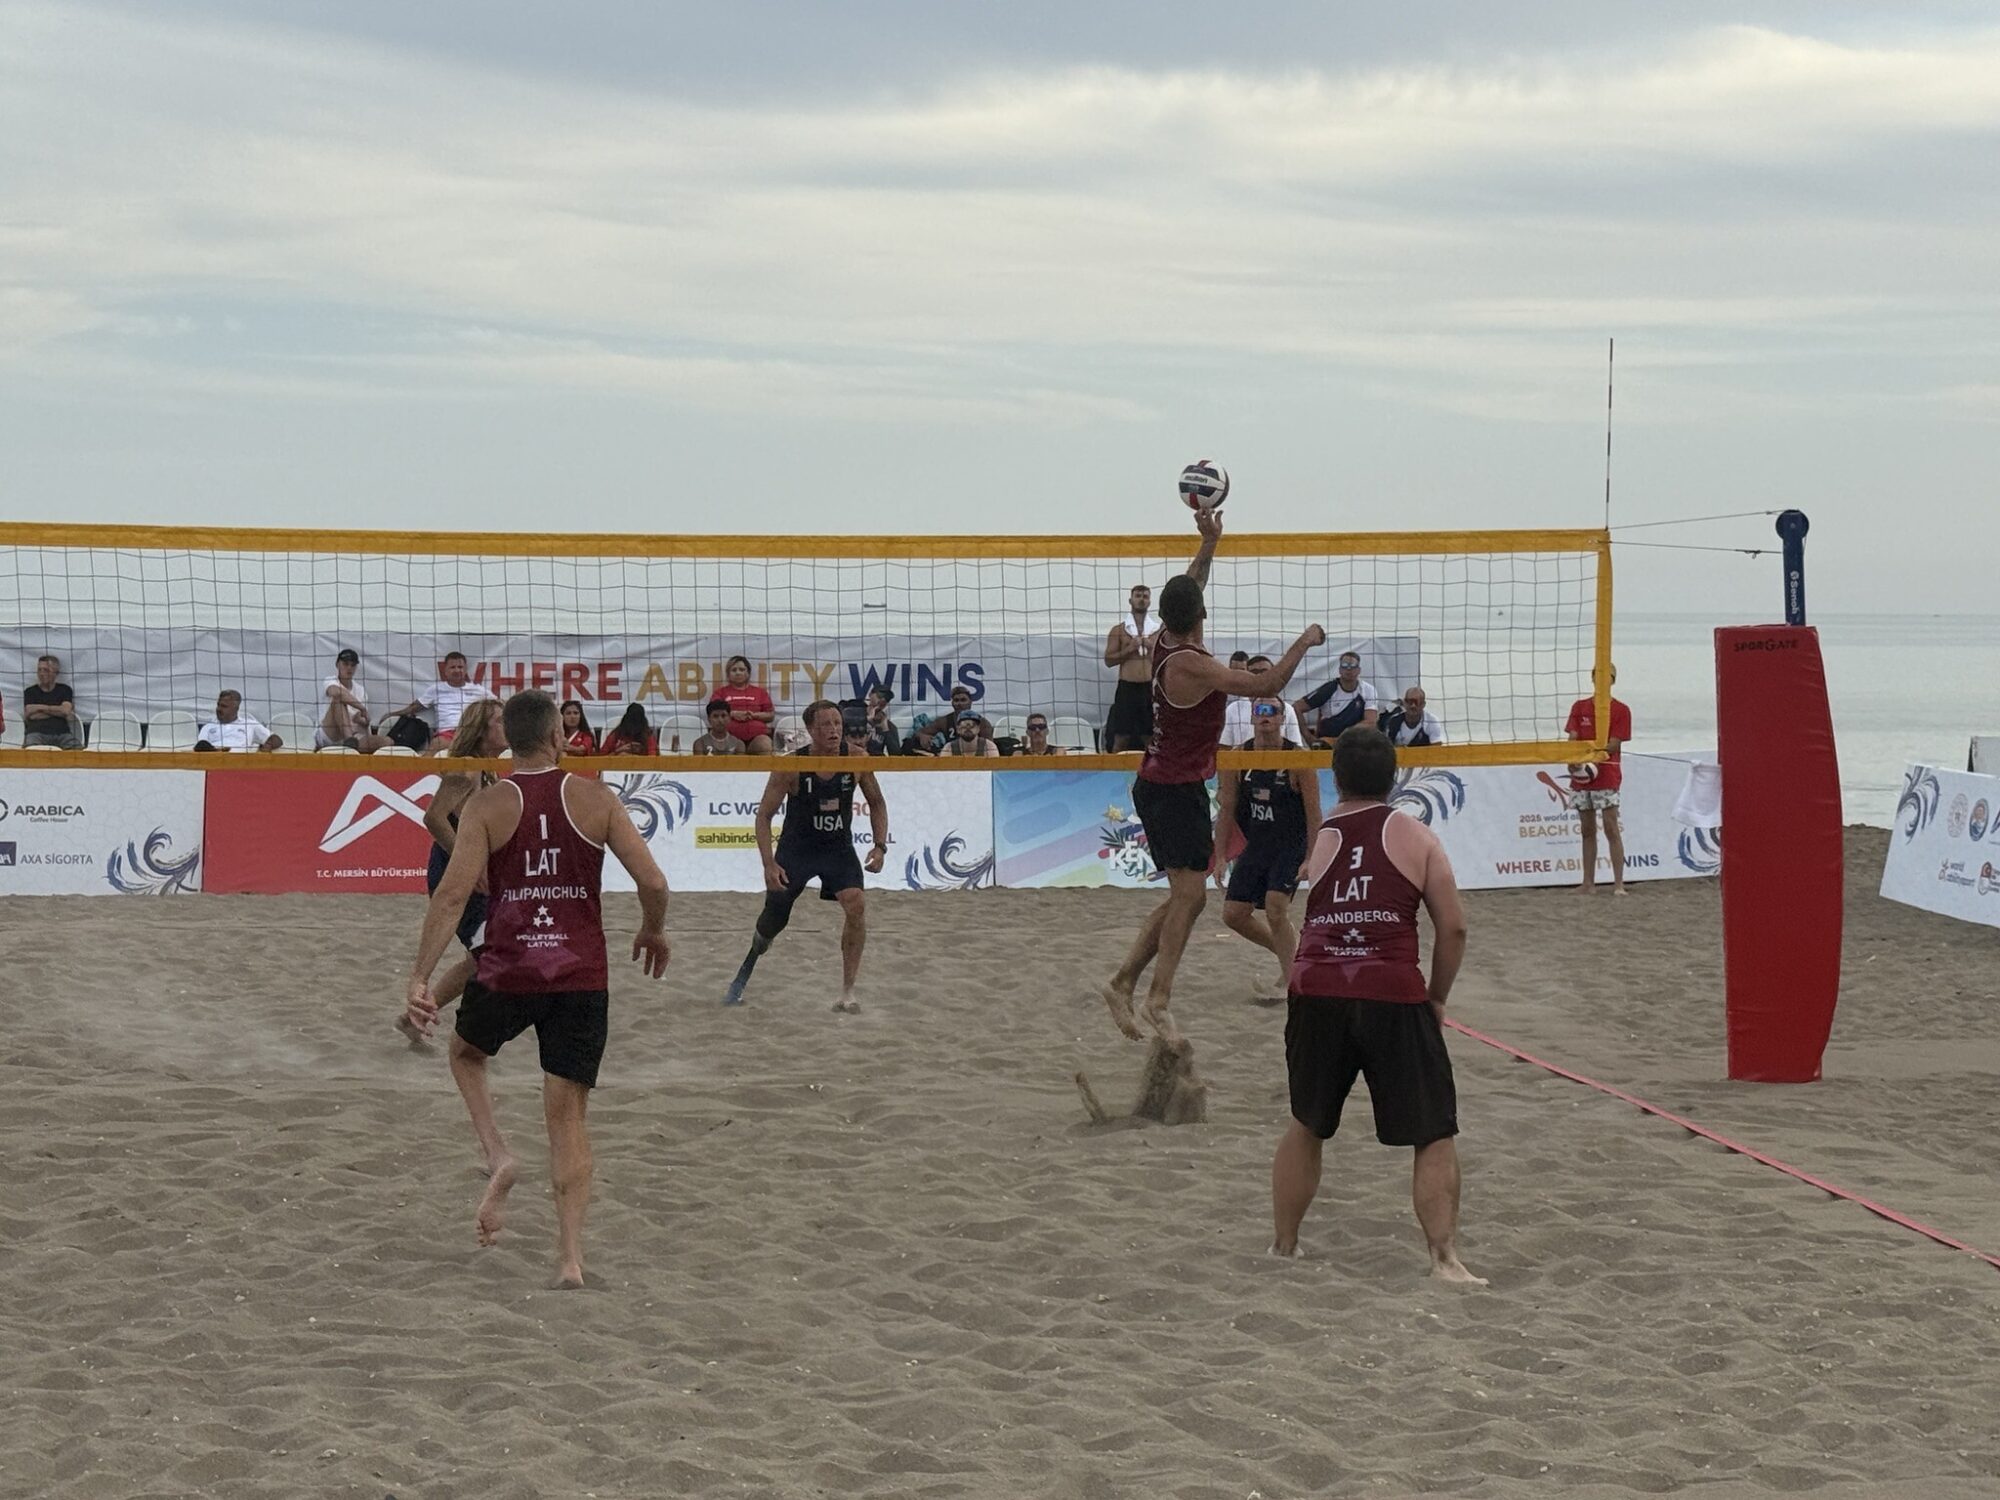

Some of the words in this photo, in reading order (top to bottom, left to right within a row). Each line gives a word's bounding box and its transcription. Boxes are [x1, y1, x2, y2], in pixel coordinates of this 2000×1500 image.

[635, 662, 837, 701] ABIITY
[848, 662, 985, 701] WINS
[805, 782, 813, 793] 1
[13, 805, 85, 816] ARABICA
[1250, 802, 1274, 821] USA
[813, 815, 844, 832] USA
[1519, 825, 1569, 838] BEACH
[20, 854, 42, 865] AXA
[45, 852, 93, 865] SİGORTA
[525, 848, 561, 877] LAT
[1349, 846, 1364, 869] 3
[1496, 860, 1550, 874] WHERE
[1554, 856, 1612, 872] ABITY
[333, 868, 368, 878] MERSİN
[1333, 875, 1373, 904] LAT
[516, 933, 570, 941] VOLLEYBALL
